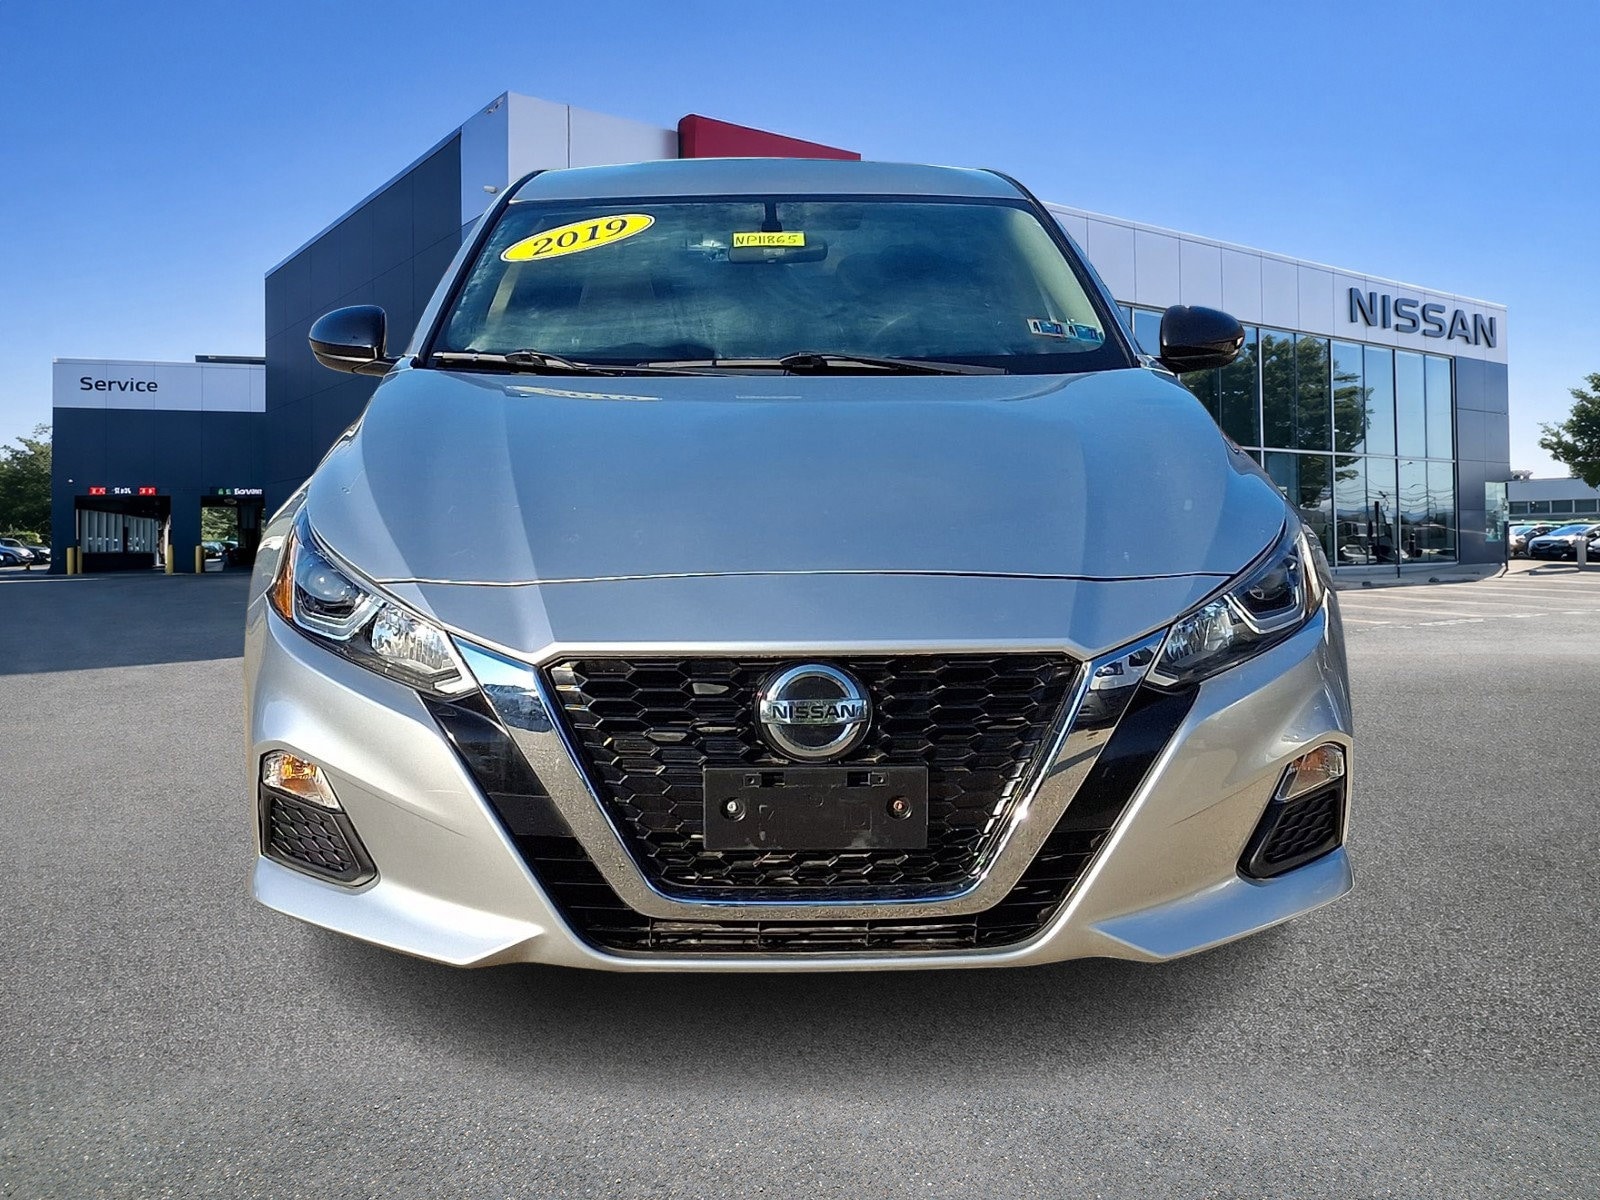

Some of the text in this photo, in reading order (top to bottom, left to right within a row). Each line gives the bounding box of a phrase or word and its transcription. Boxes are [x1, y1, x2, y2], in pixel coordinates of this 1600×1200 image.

[533, 218, 628, 256] 2019
[735, 235, 799, 245] NP11865
[1348, 287, 1497, 348] NISSAN
[79, 376, 158, 392] Service
[772, 704, 856, 719] NISSAN
